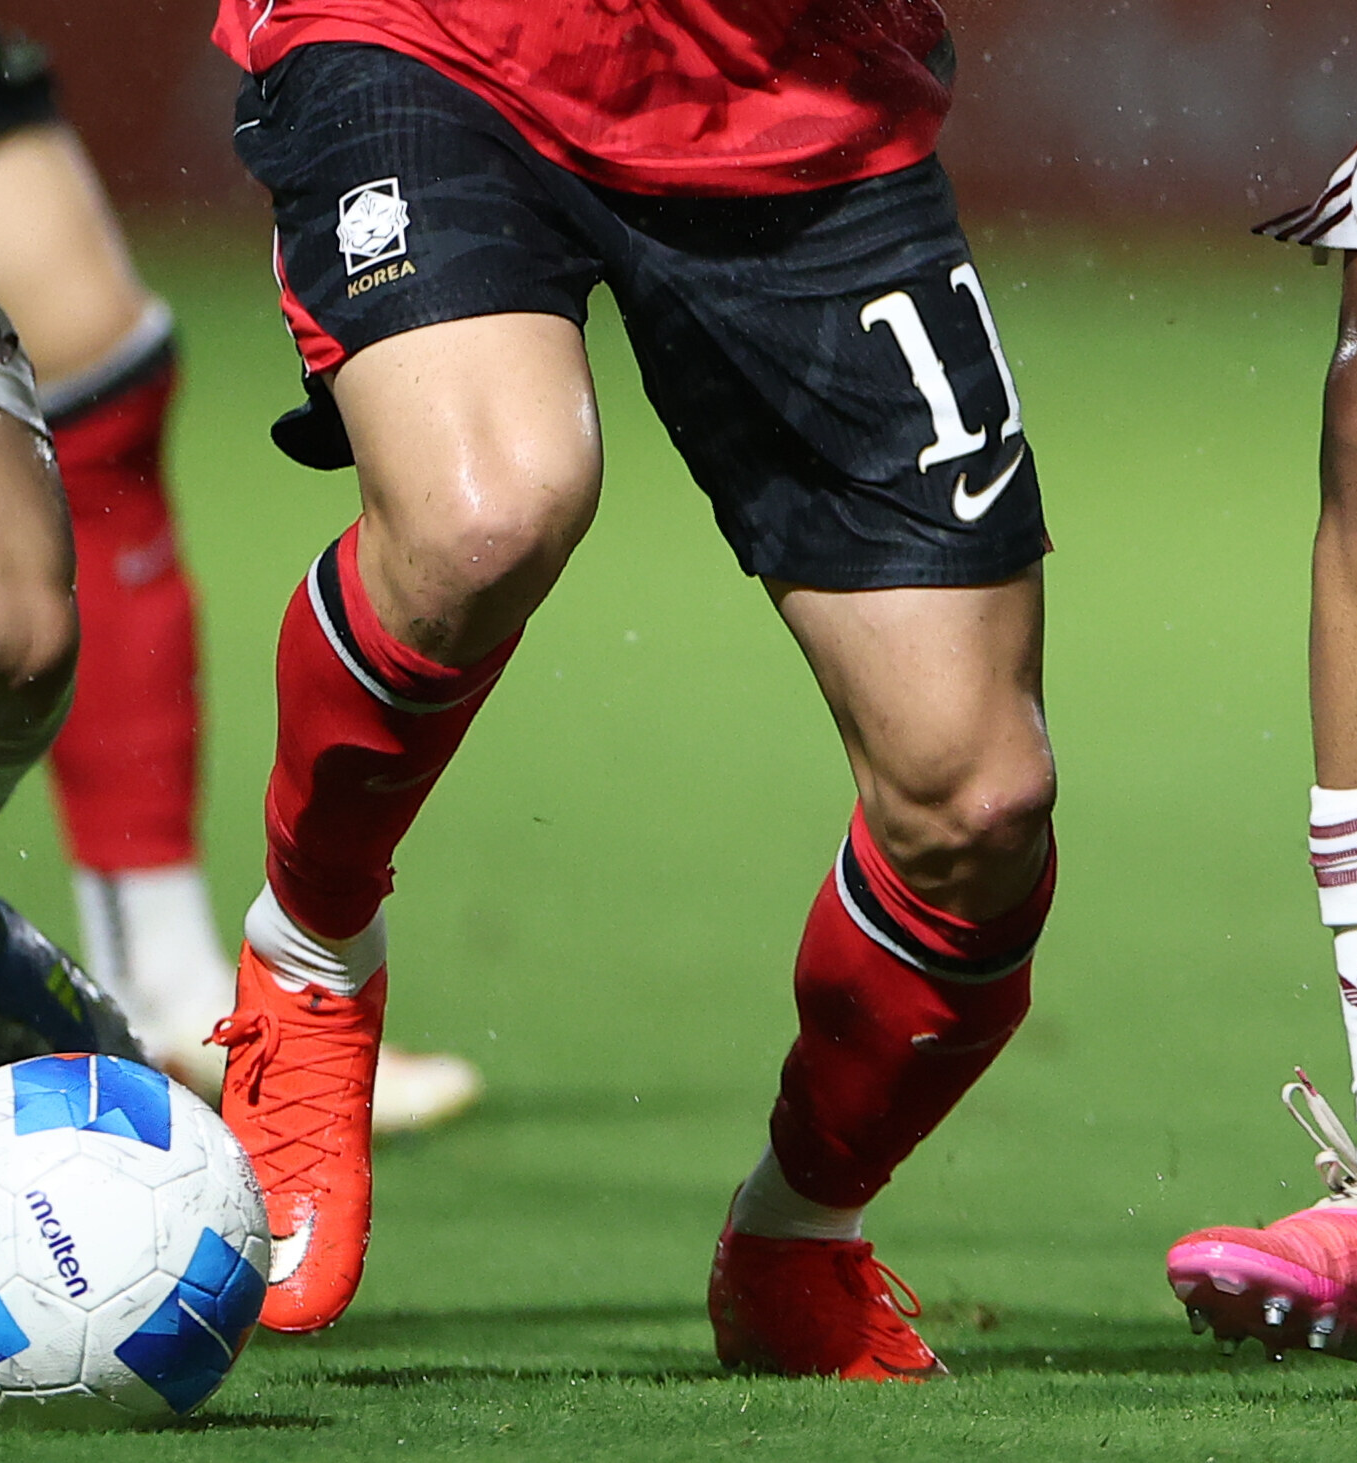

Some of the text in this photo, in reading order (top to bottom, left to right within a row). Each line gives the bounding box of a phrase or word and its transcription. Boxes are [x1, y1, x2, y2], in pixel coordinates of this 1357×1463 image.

[347, 260, 416, 299] KOREA
[859, 262, 1023, 475] 11
[26, 1190, 88, 1299] molten
